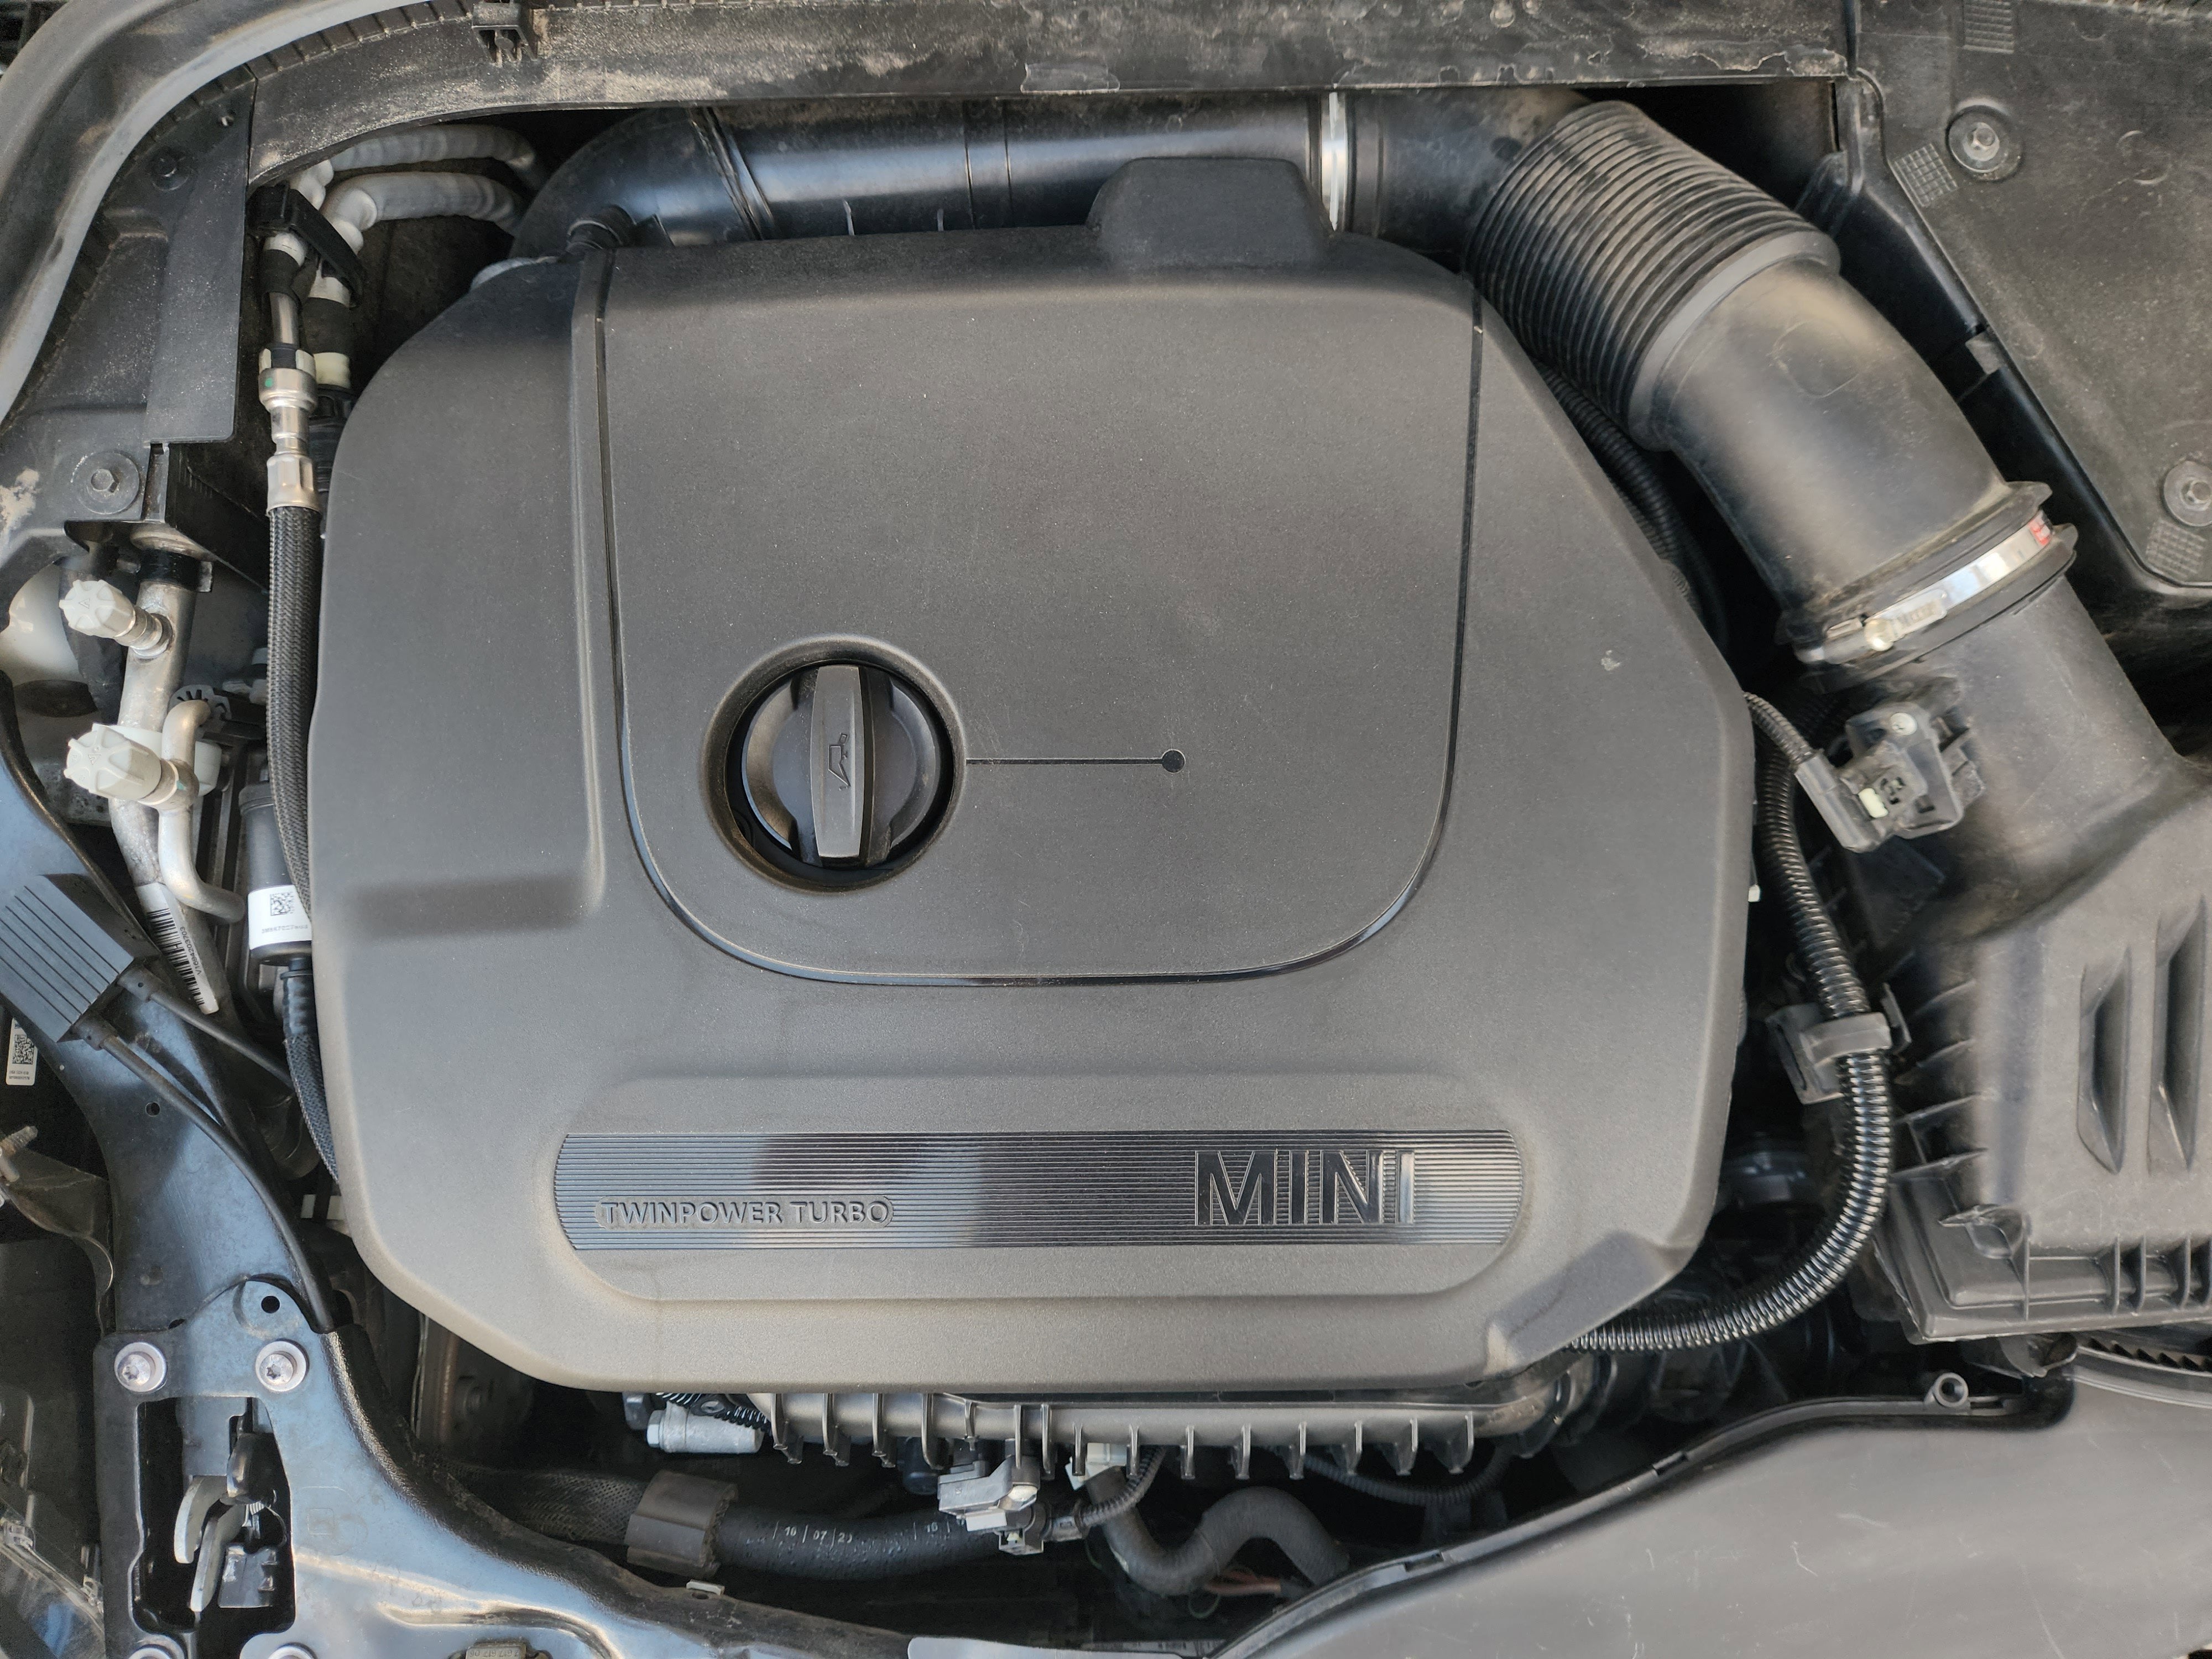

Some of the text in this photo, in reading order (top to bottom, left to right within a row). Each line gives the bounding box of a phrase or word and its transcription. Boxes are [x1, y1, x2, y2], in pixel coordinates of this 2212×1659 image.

[1194, 1150, 1415, 1225] MINI
[601, 1201, 889, 1224] TWINPOWER TURBO
